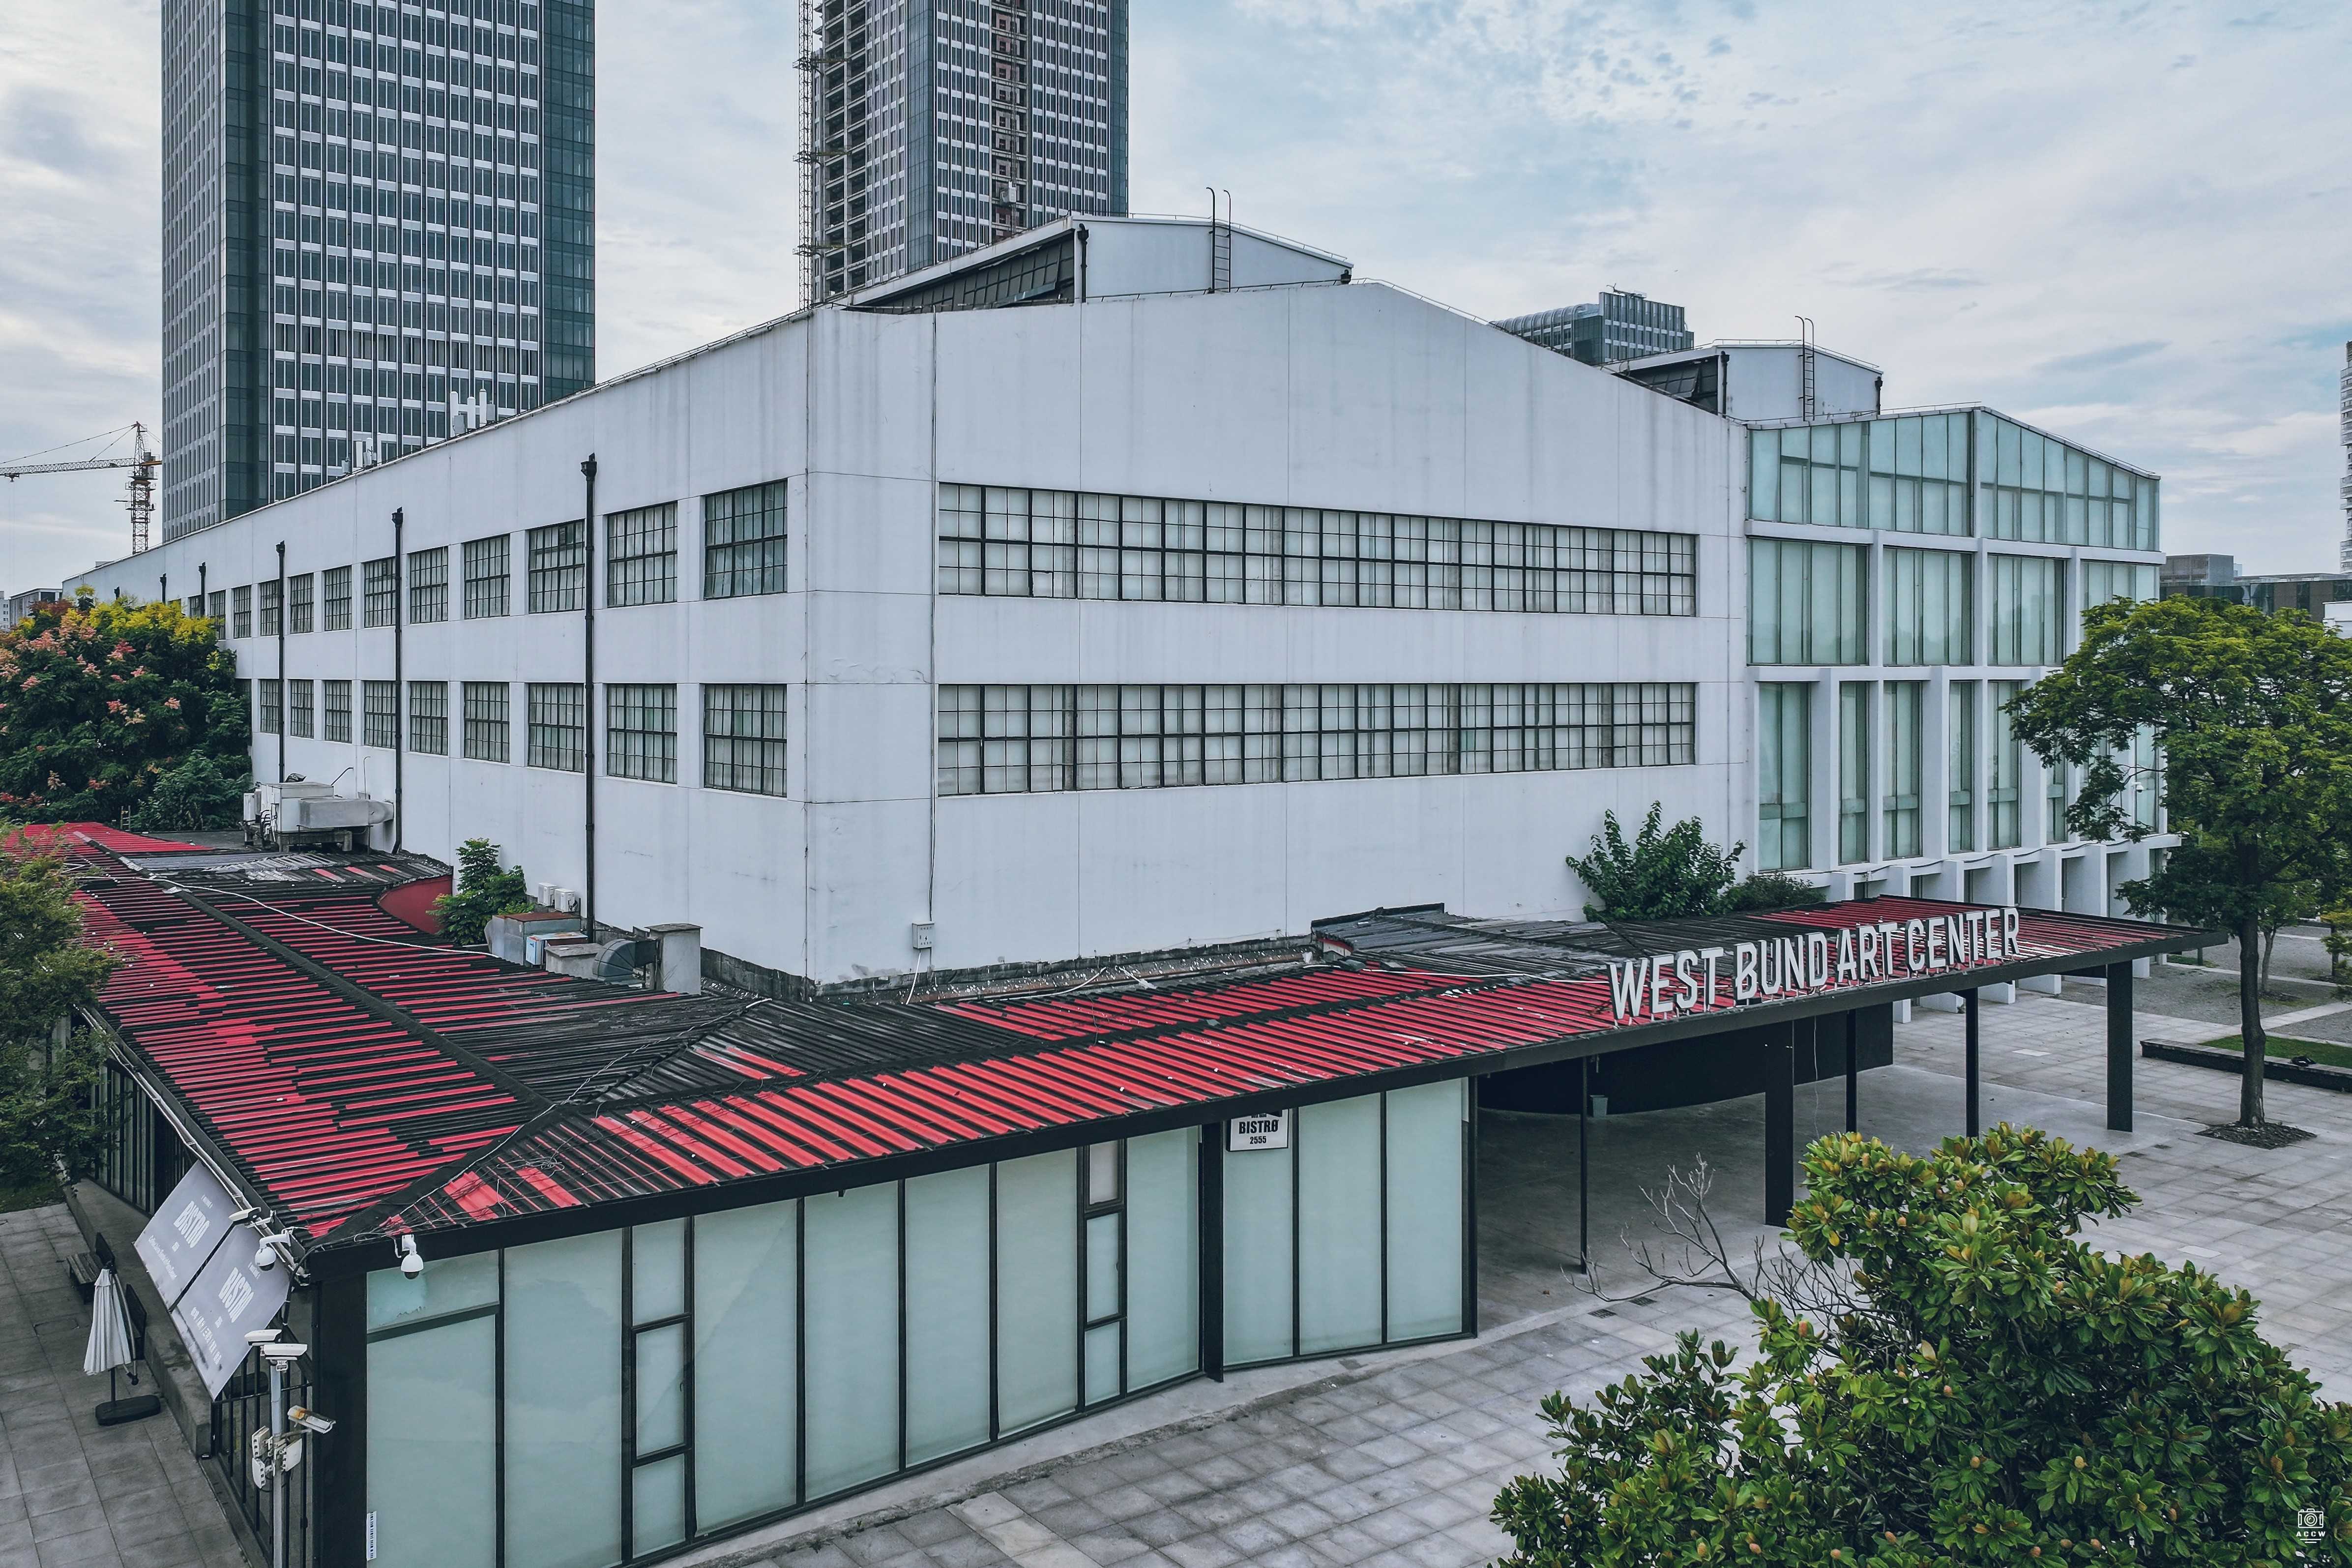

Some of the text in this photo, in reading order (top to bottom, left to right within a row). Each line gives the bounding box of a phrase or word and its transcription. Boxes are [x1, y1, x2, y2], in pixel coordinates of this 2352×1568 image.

[1607, 907, 2020, 1019] WEST BUND ART CENTER
[1250, 1136, 1266, 1144] 2555
